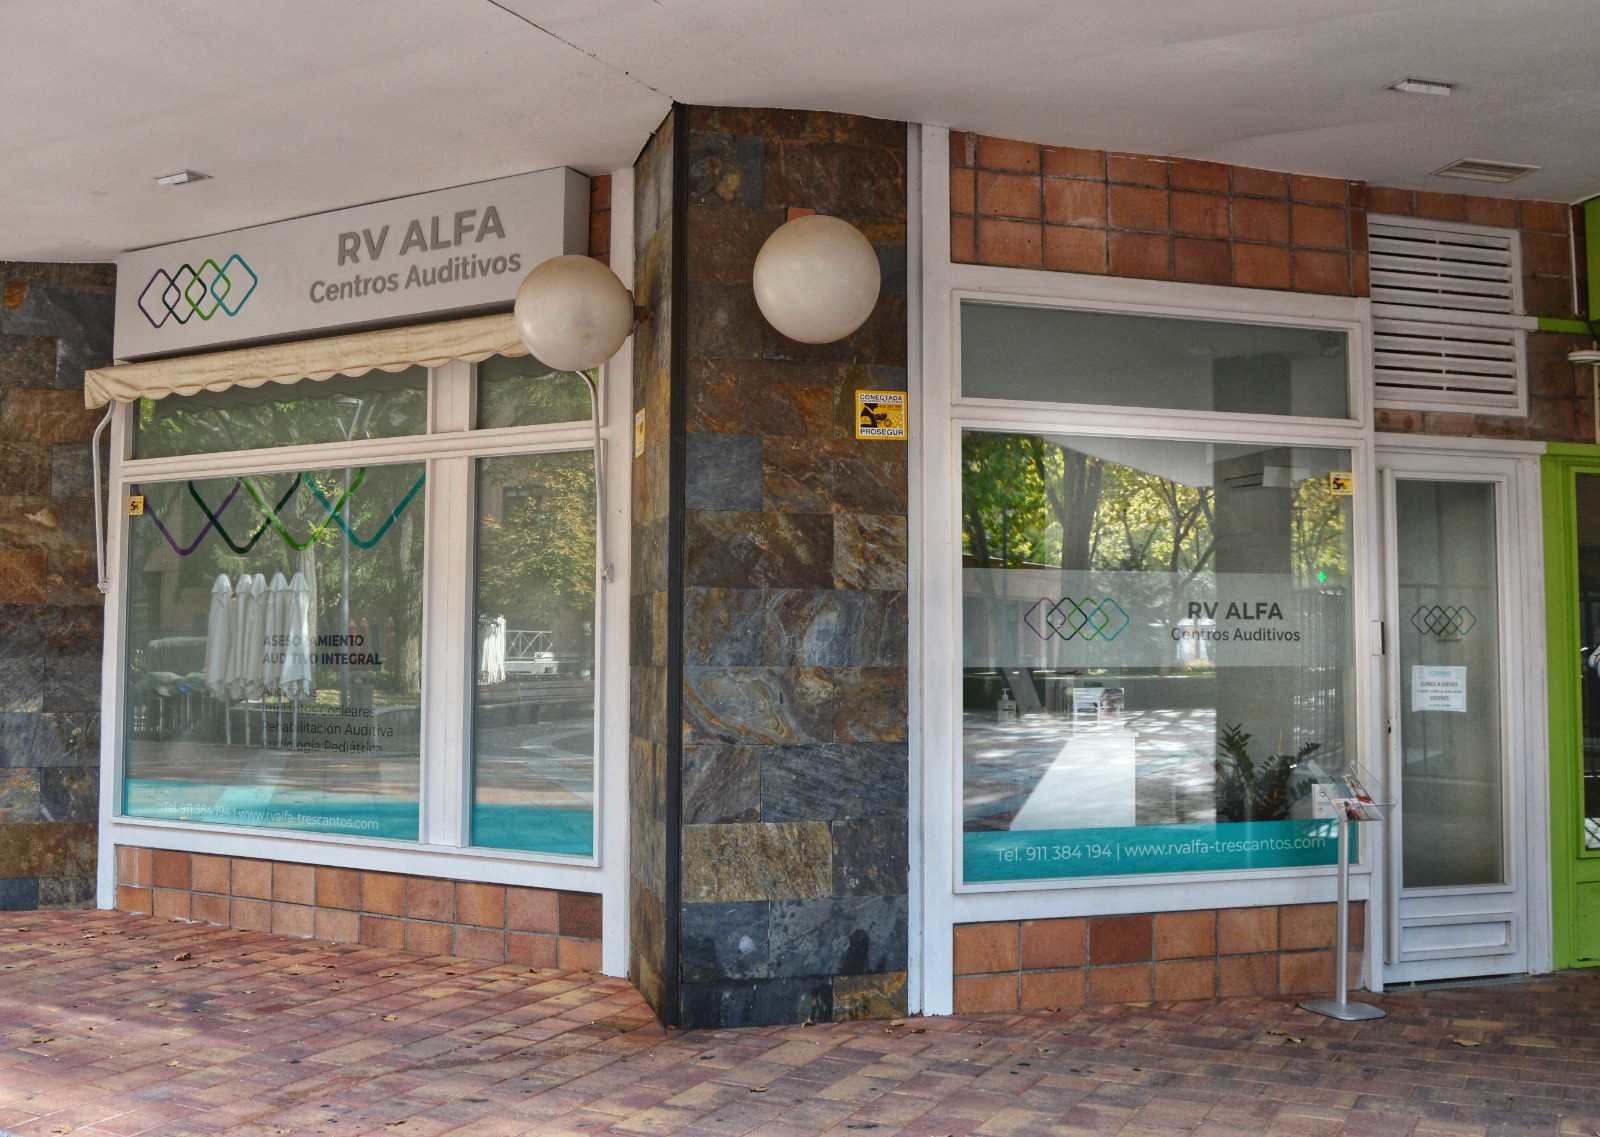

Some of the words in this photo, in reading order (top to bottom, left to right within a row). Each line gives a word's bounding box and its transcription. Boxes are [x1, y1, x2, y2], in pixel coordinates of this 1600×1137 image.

[338, 225, 389, 266] RV
[399, 205, 506, 256] ALFA
[309, 273, 399, 304] Centros
[404, 253, 521, 289] Auditivos
[1188, 602, 1219, 619] RV
[1225, 602, 1284, 620] ALFA
[1171, 627, 1229, 642] Centros
[1233, 626, 1301, 642] Auditivos
[321, 652, 382, 665] INTEGRAL
[320, 704, 376, 718] Cocleares
[344, 723, 394, 738] Auditiva
[324, 739, 383, 755] Pediátrica
[180, 803, 193, 814] 911
[195, 804, 214, 816] 384
[215, 805, 232, 817] 194
[238, 809, 379, 831] www.rvalfa-trescantos.com
[996, 847, 1023, 862] Tel.
[1026, 846, 1048, 861] 911
[1051, 844, 1082, 860] 384
[1086, 843, 1113, 859] 194
[1124, 835, 1326, 858] www.rvalfa-trescantos.com
